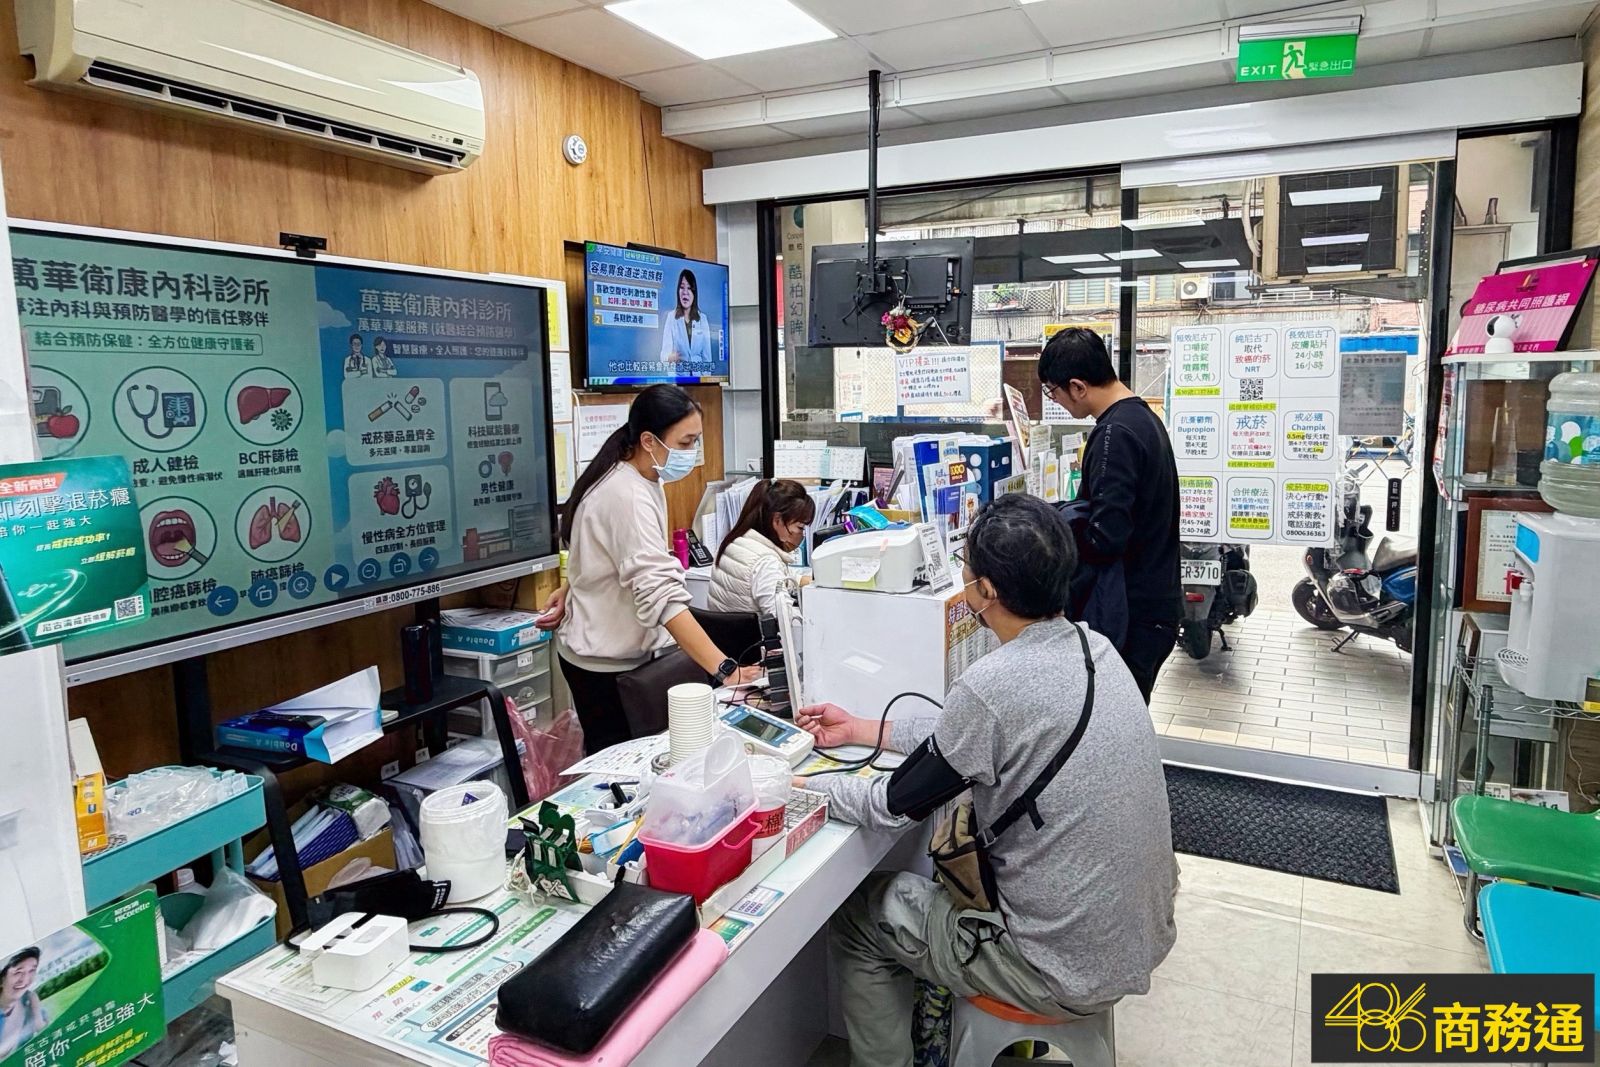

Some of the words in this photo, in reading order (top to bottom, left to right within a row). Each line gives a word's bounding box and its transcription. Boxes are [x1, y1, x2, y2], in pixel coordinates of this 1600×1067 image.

[1240, 64, 1277, 76] EXIT
[1308, 59, 1353, 72] 緊急出口
[591, 261, 663, 282] 容易胃食道逆流族群
[12, 257, 271, 307] 萬華衛康內科診所
[359, 289, 513, 322] 萬華衛康內科診所
[1473, 293, 1570, 315] 糖尿病共同照護網
[1289, 329, 1332, 339] 長效尼古丁
[35, 331, 256, 352] 結合預防保健：全方位健康守護者
[1291, 340, 1328, 350] 皮膚貼片
[1244, 344, 1263, 353] 取代
[1235, 355, 1271, 364] 致癌的菸
[1295, 351, 1324, 360] 24小時
[1295, 361, 1324, 370] 16小時
[1236, 414, 1268, 430] 戒菸
[1295, 413, 1324, 422] 戒必適
[1177, 426, 1216, 434] Bupropion
[1292, 423, 1326, 432] Champix
[361, 428, 436, 445] 戒菸藥品最齊全
[239, 448, 299, 465] BC肝篩檢
[133, 455, 199, 474] 成人健檢
[1233, 488, 1269, 497] 合併療法
[0, 487, 132, 521] 即刻擊退菸癮
[362, 520, 446, 545] 慢性病全方位管理
[150, 578, 217, 603] 腔癌篩檢
[457, 635, 464, 643] A
[466, 637, 495, 647] Double
[264, 740, 298, 751] Double
[114, 902, 150, 923] nicorette
